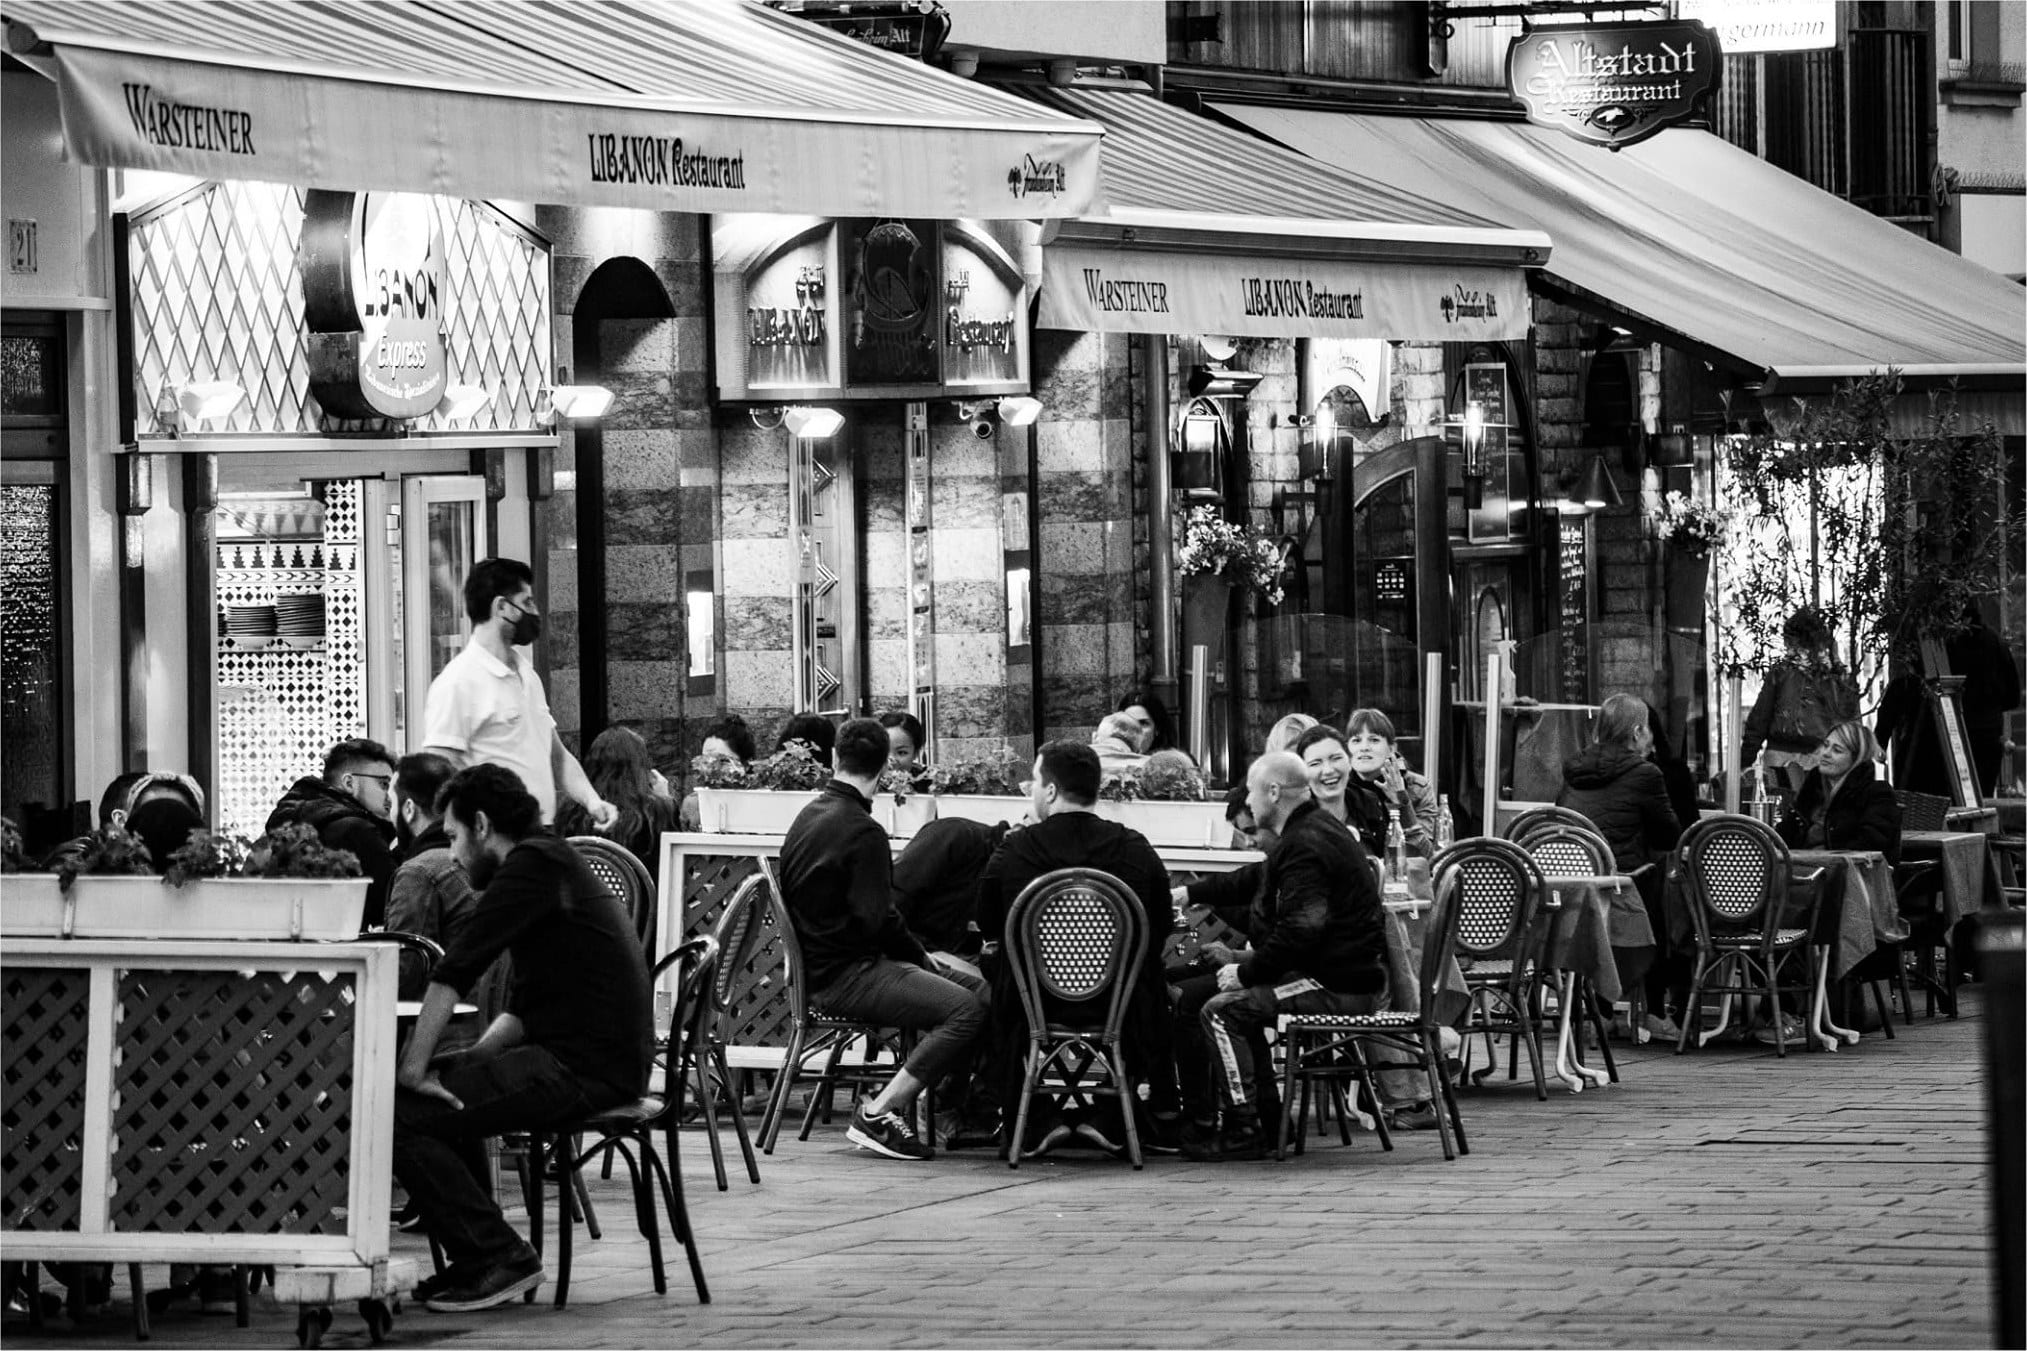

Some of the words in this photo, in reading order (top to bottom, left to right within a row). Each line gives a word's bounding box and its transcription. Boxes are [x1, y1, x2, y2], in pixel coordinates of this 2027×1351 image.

[1535, 40, 1698, 78] Altstadt
[1526, 76, 1683, 108] Restaurant
[588, 133, 668, 185] LIBANON
[671, 137, 746, 189] Restaurant
[16, 228, 32, 267] 21
[1241, 278, 1307, 318] LIBANON
[1307, 279, 1364, 319] Restaurant
[376, 329, 427, 381] Express
